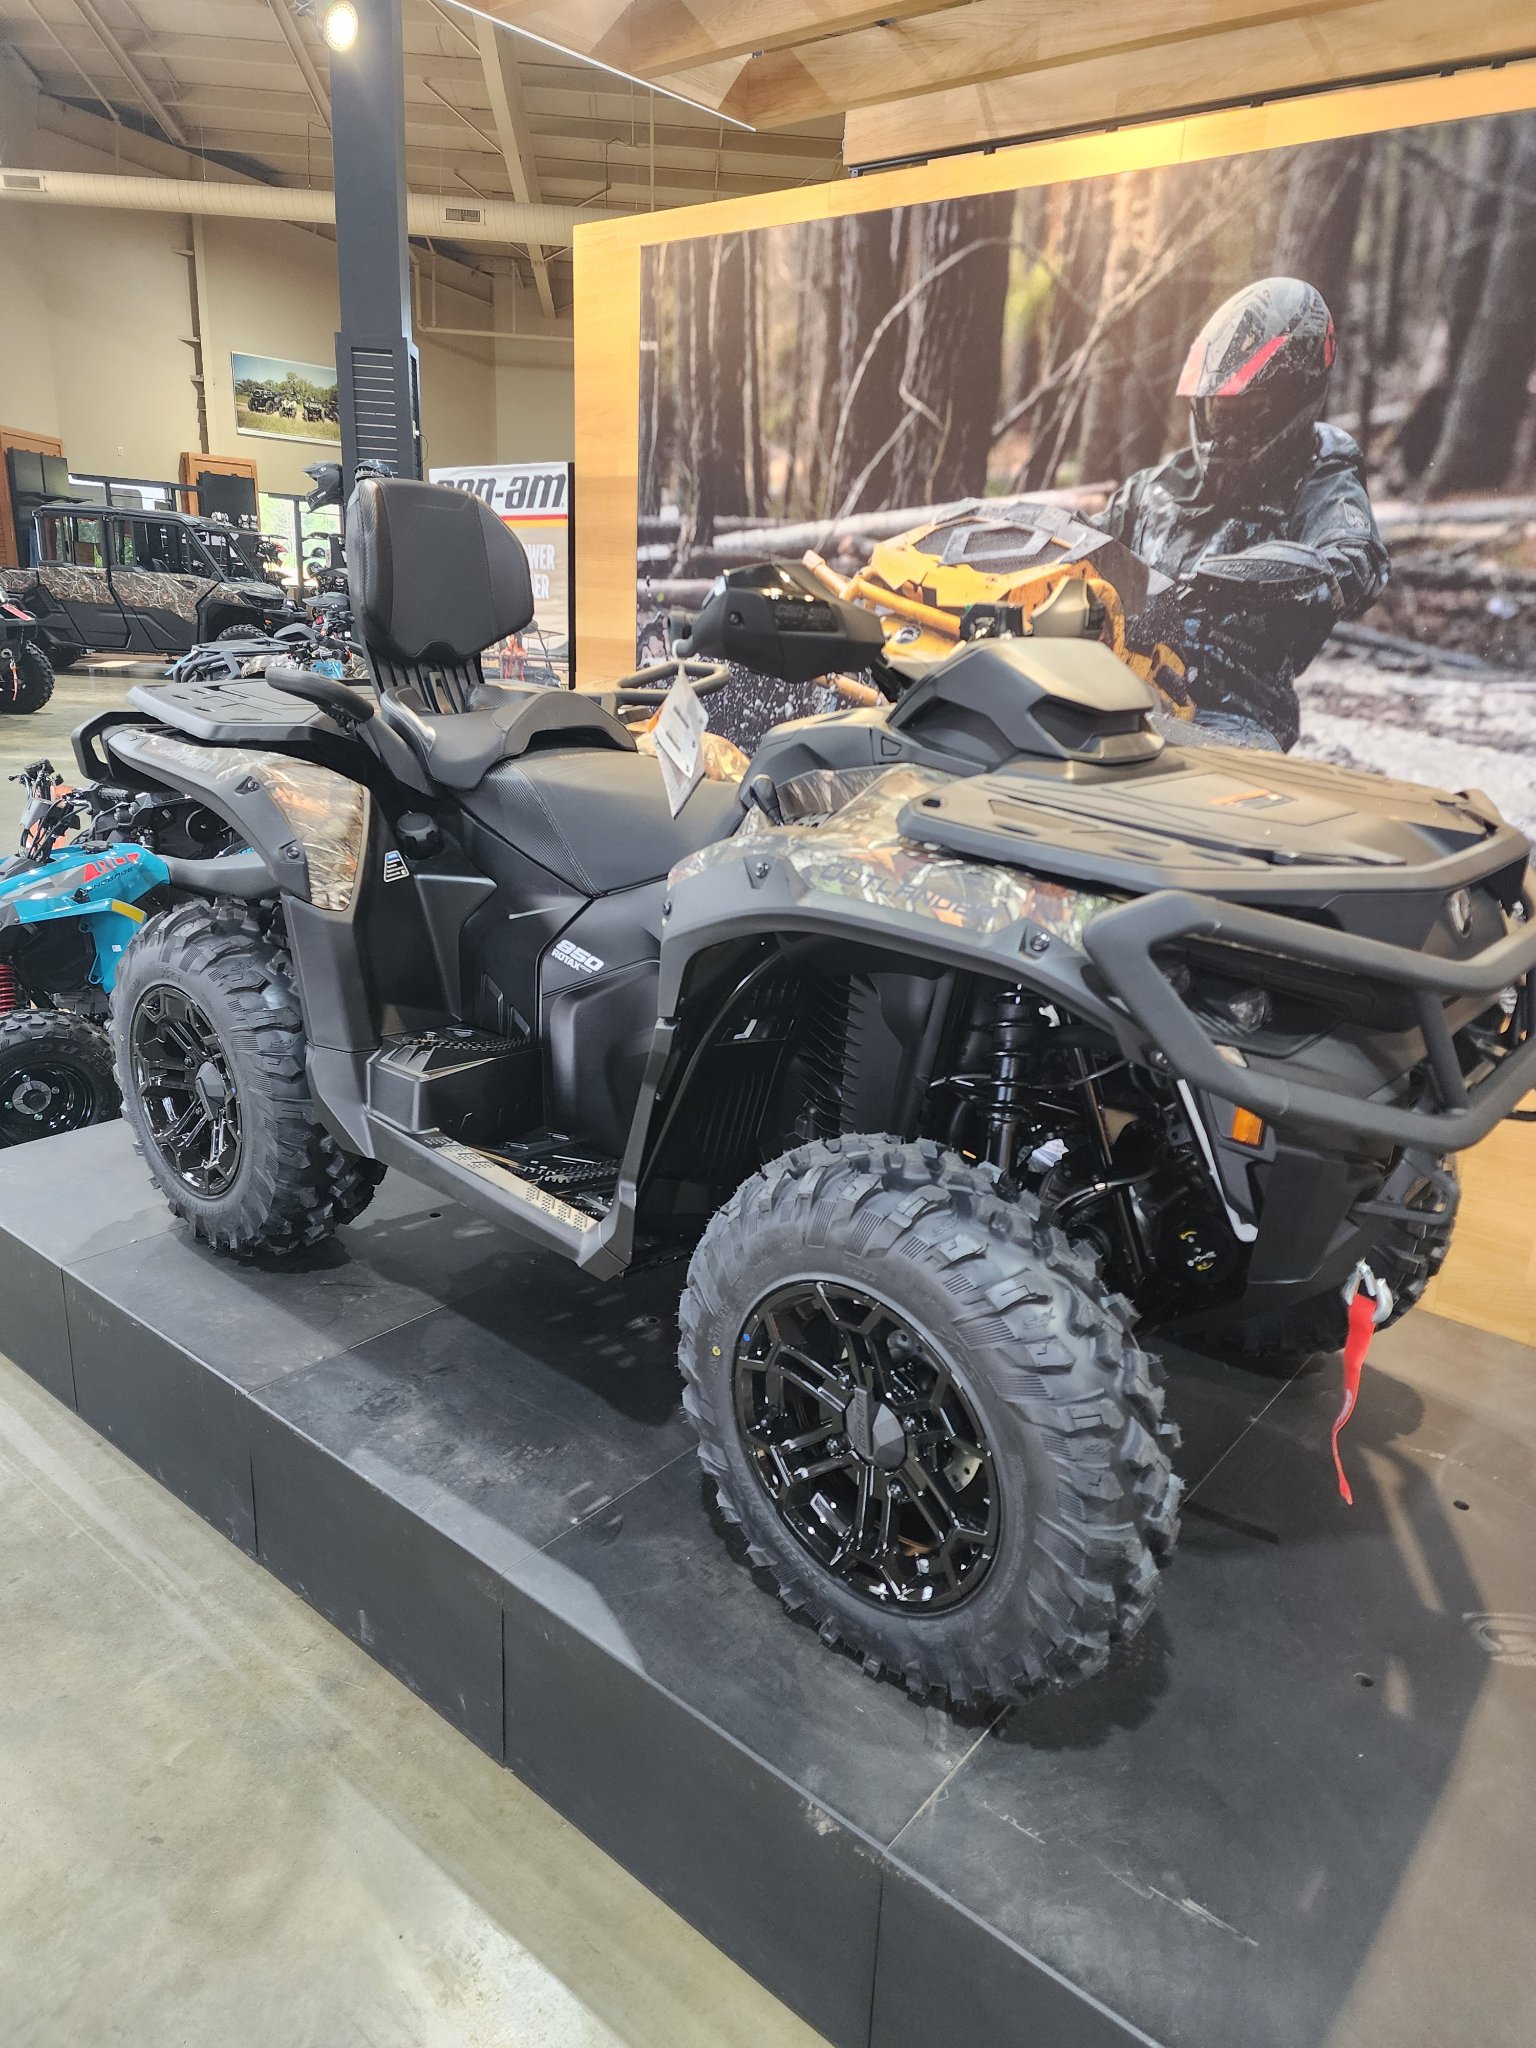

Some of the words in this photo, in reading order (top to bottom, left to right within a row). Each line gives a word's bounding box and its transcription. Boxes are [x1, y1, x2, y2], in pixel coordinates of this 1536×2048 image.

[437, 474, 566, 509] n-am
[523, 543, 556, 571] WER
[819, 862, 997, 923] OUTLANDER
[551, 948, 581, 971] ROTAX
[555, 939, 605, 972] 850
